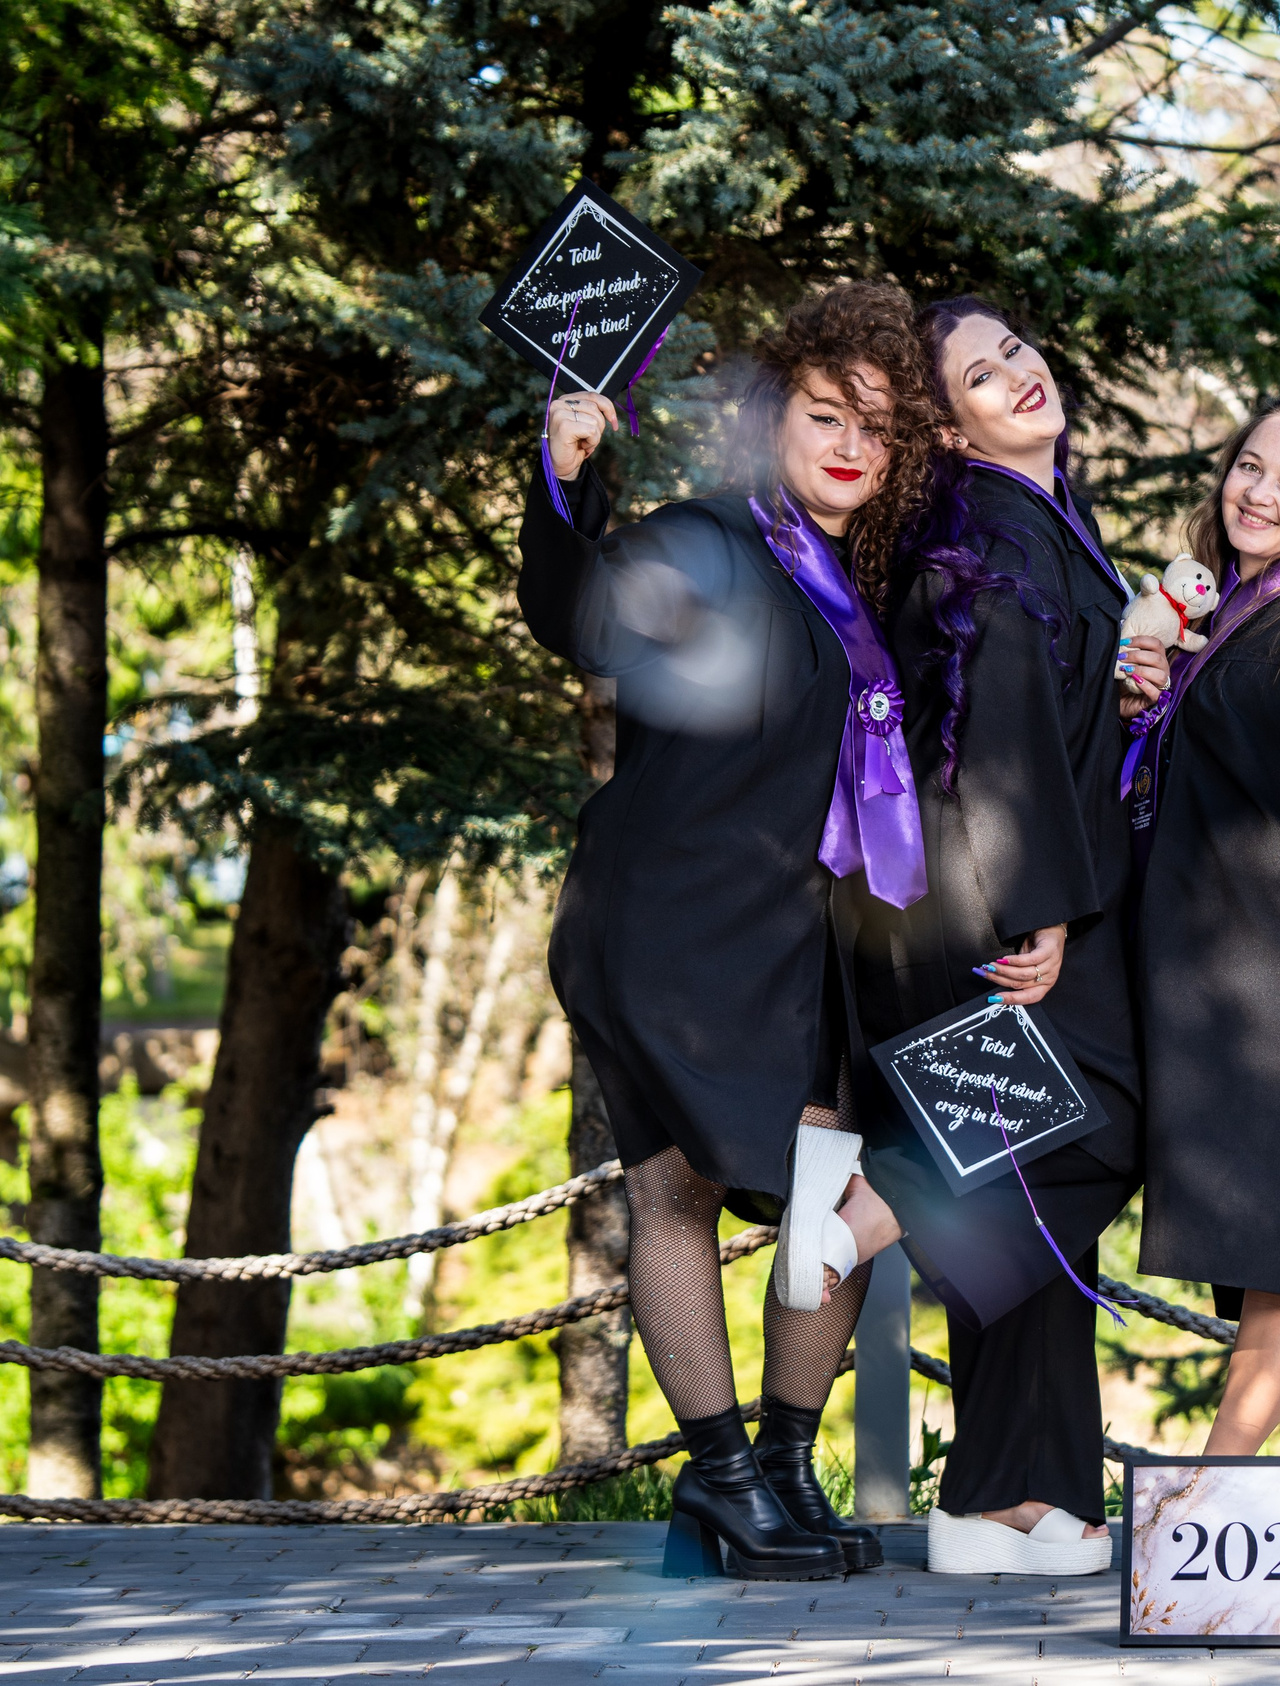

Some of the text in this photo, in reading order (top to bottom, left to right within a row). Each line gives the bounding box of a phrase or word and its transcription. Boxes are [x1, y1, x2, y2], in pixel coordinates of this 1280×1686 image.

[569, 242, 601, 266] Totul
[535, 271, 640, 312] este posibil când
[585, 323, 599, 338] în
[600, 313, 630, 335] tine!
[980, 1035, 1016, 1058] Totul
[929, 1062, 1047, 1102] este posibil când
[935, 1100, 1023, 1133] crezi în tine!
